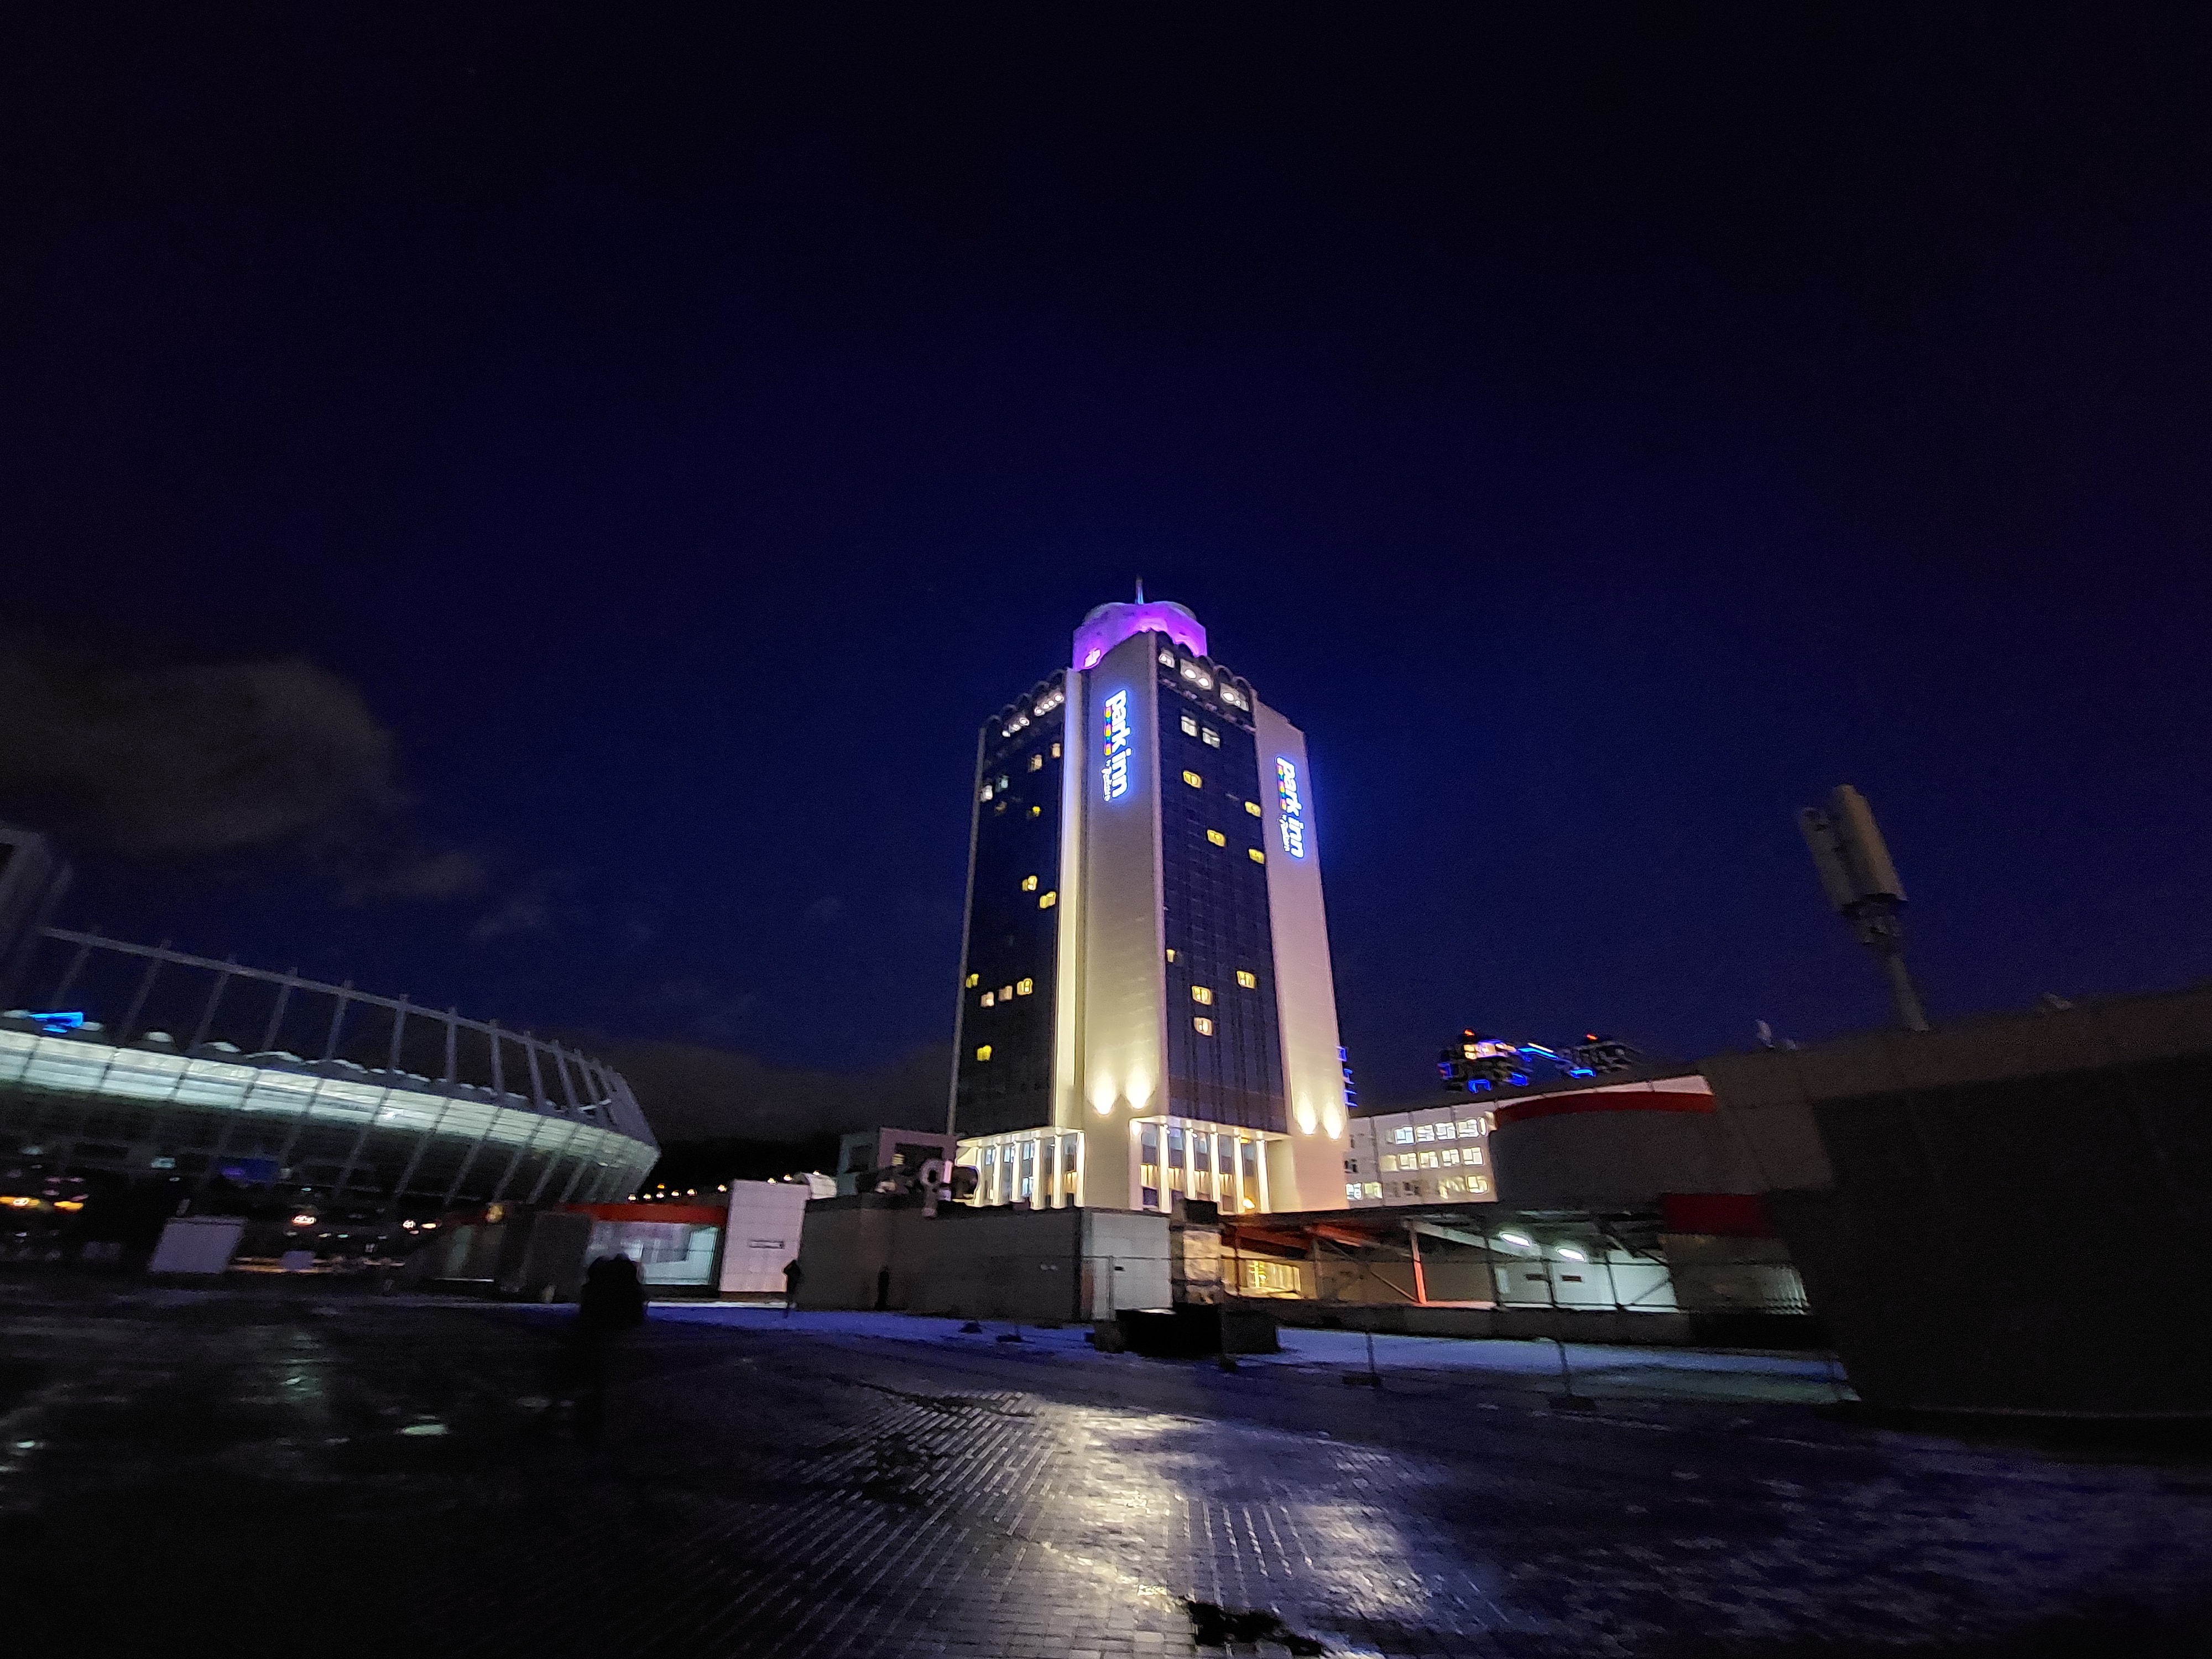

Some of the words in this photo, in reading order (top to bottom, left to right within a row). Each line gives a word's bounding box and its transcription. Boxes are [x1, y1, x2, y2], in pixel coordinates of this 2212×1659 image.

[1105, 690, 1131, 753] park
[1112, 748, 1131, 798] inn
[1276, 757, 1302, 817] park
[1288, 816, 1305, 858] inn
